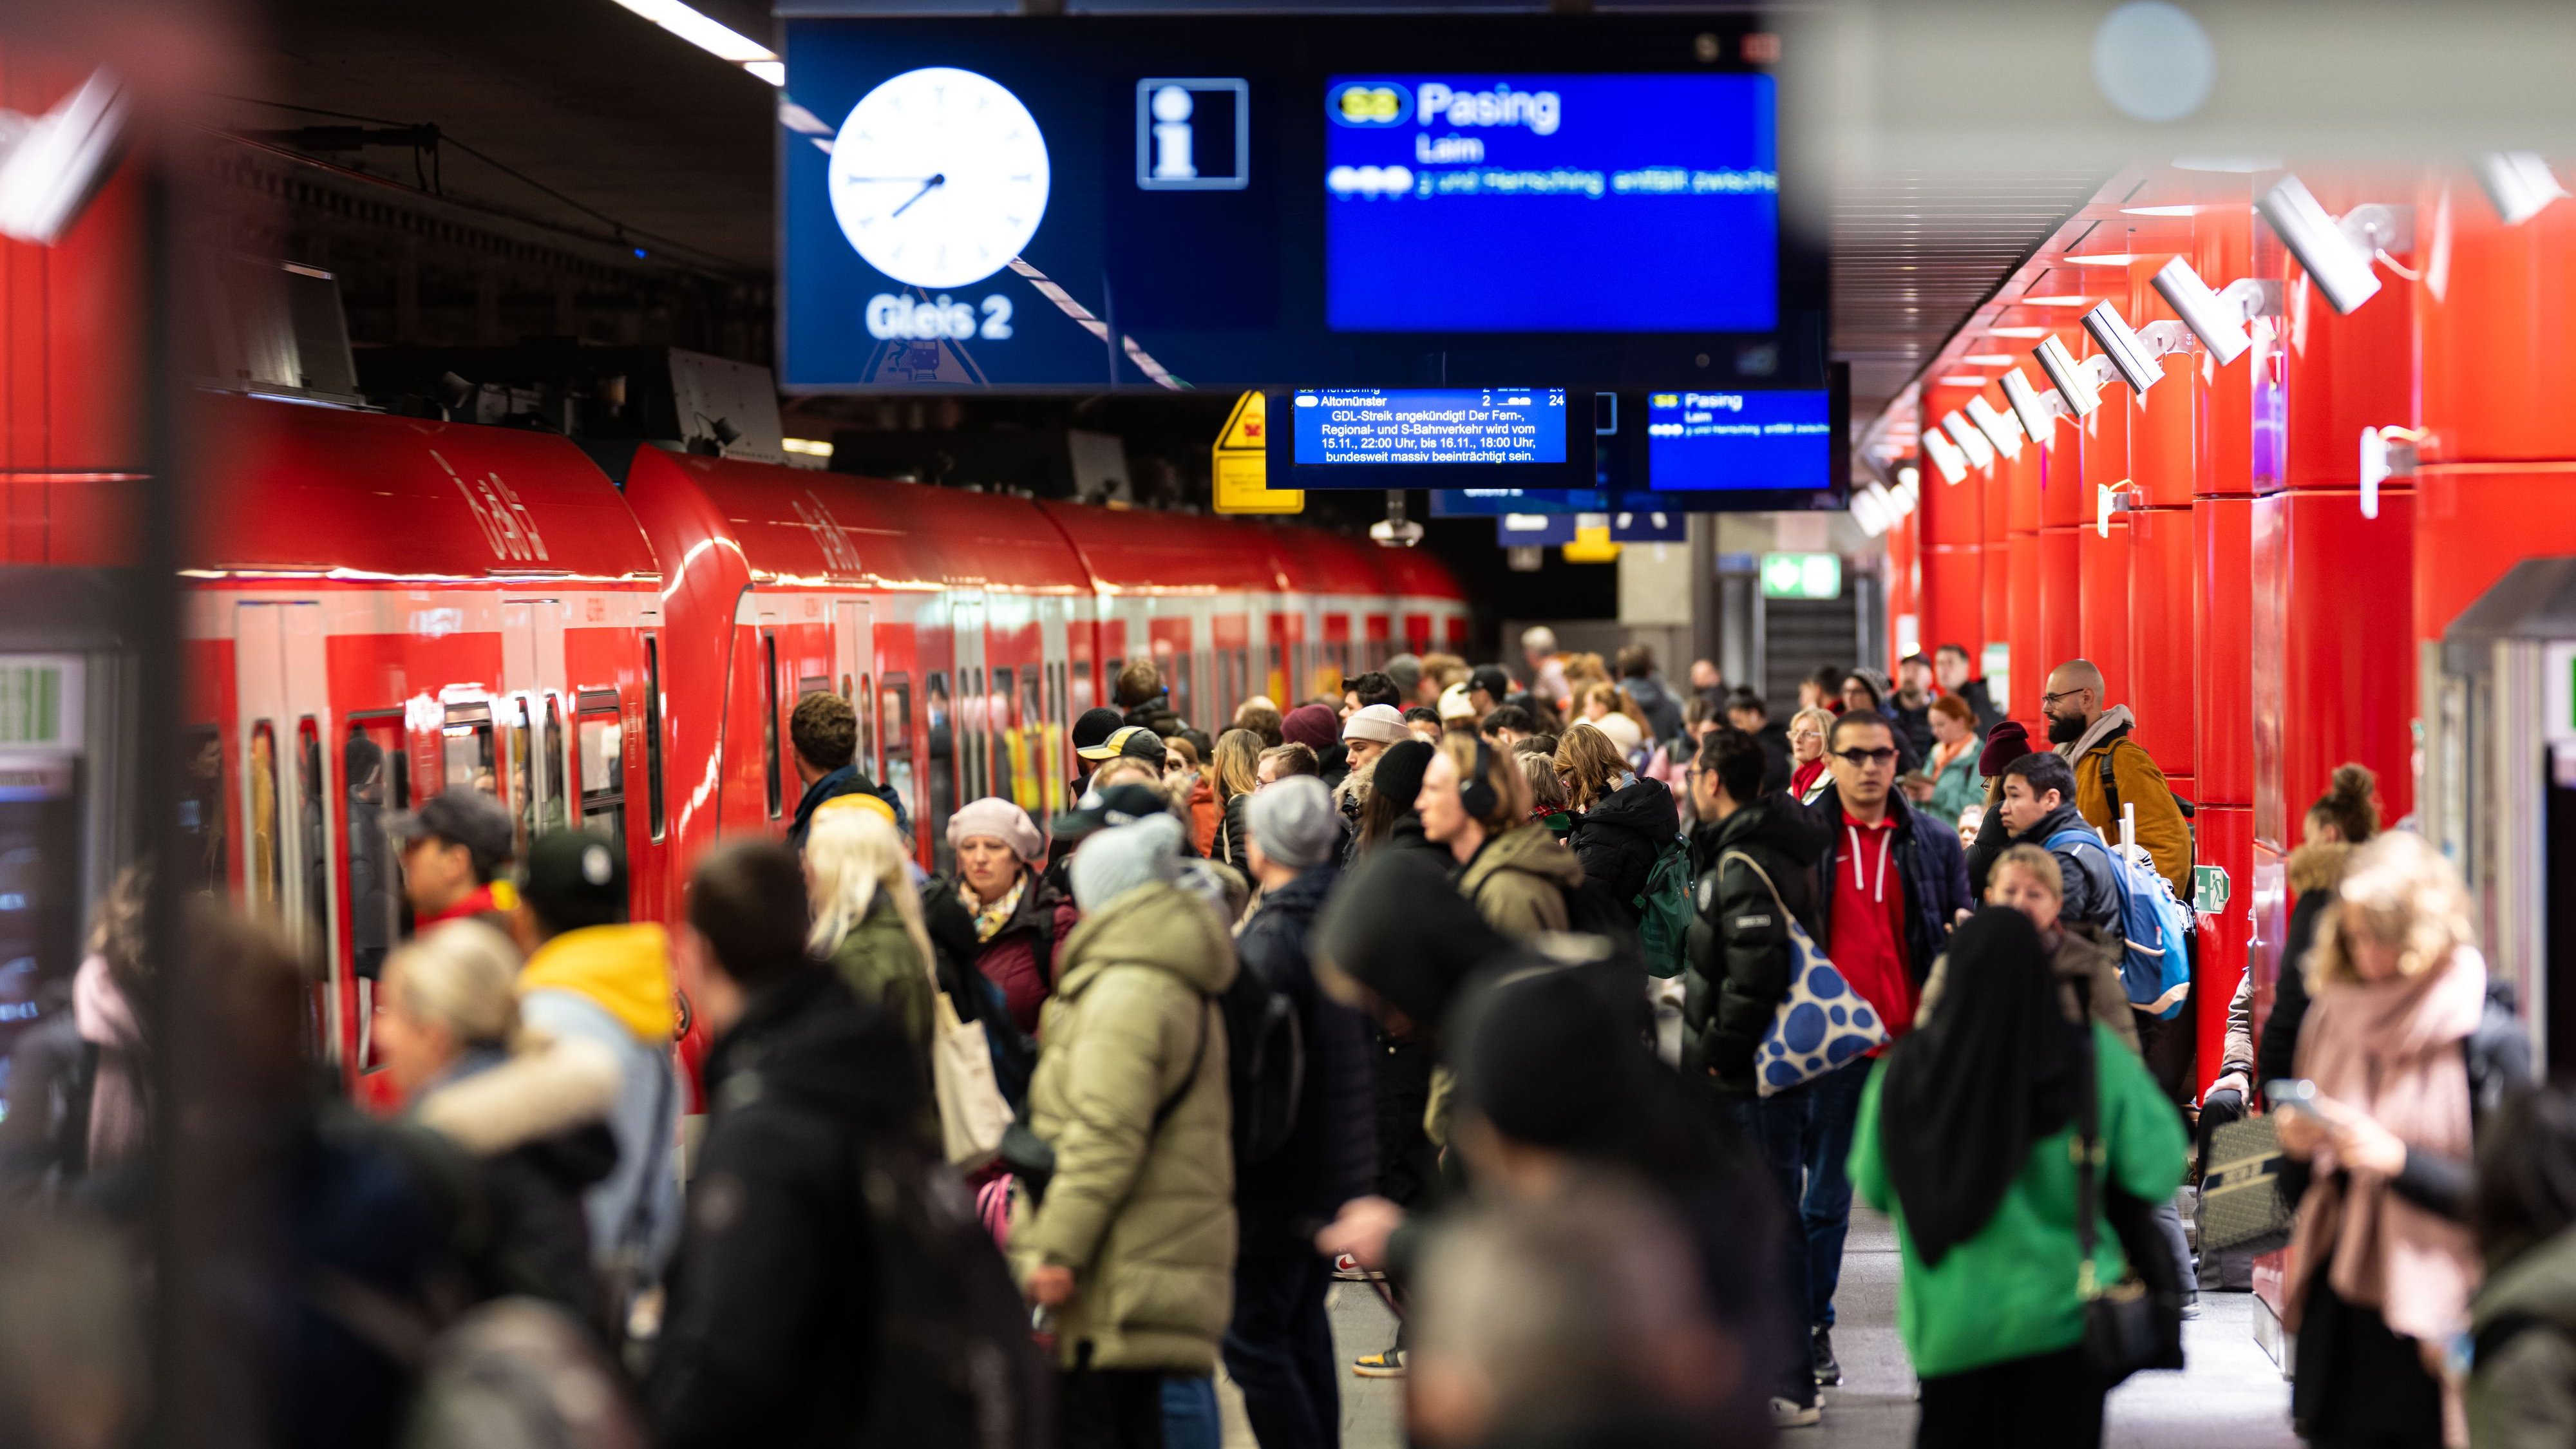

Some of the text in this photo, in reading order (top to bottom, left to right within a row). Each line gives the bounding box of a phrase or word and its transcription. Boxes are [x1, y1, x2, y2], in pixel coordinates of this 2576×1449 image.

[1417, 82, 1560, 136] Pasing
[1416, 132, 1484, 164] Laim
[866, 294, 1014, 340] Gleis 2
[1321, 395, 1564, 406] Altomünster 2 24
[1685, 393, 1743, 412] Pasing
[1332, 410, 1524, 423] GDL-Streik angekündigt! Der Fern-,
[1322, 424, 1535, 437] Regional- und S-Bahnverkehr wird vom
[1322, 437, 1536, 450] 15.11., 22:00 Uhr, bis 16.11., 18:00 Uhr,
[1326, 451, 1534, 464] bundesweit massiv beeinträchtigt sein.
